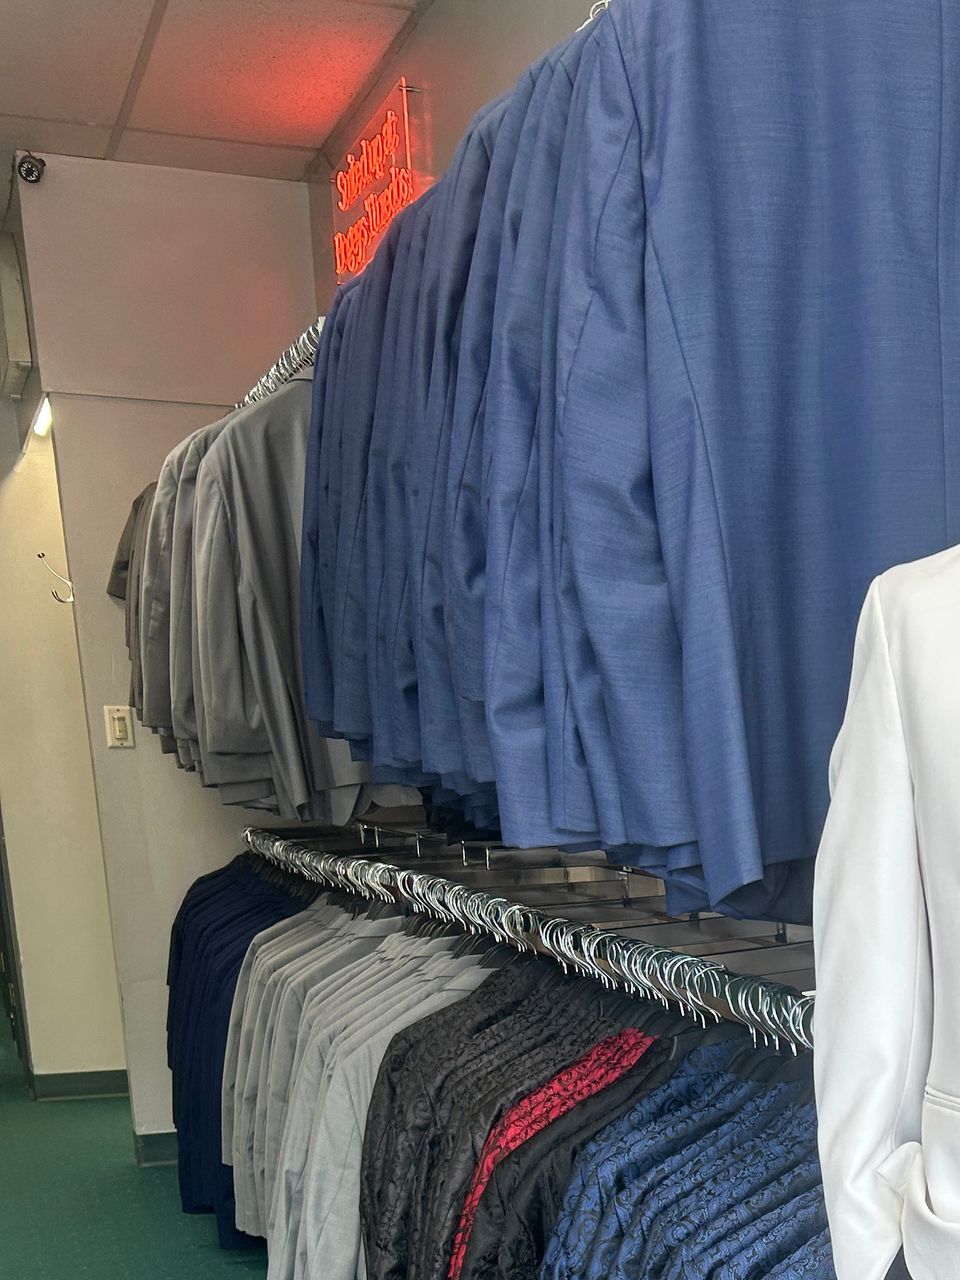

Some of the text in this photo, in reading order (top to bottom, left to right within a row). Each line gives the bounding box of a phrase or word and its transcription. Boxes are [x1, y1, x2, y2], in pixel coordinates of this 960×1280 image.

[336, 110, 399, 211] Suited up at
